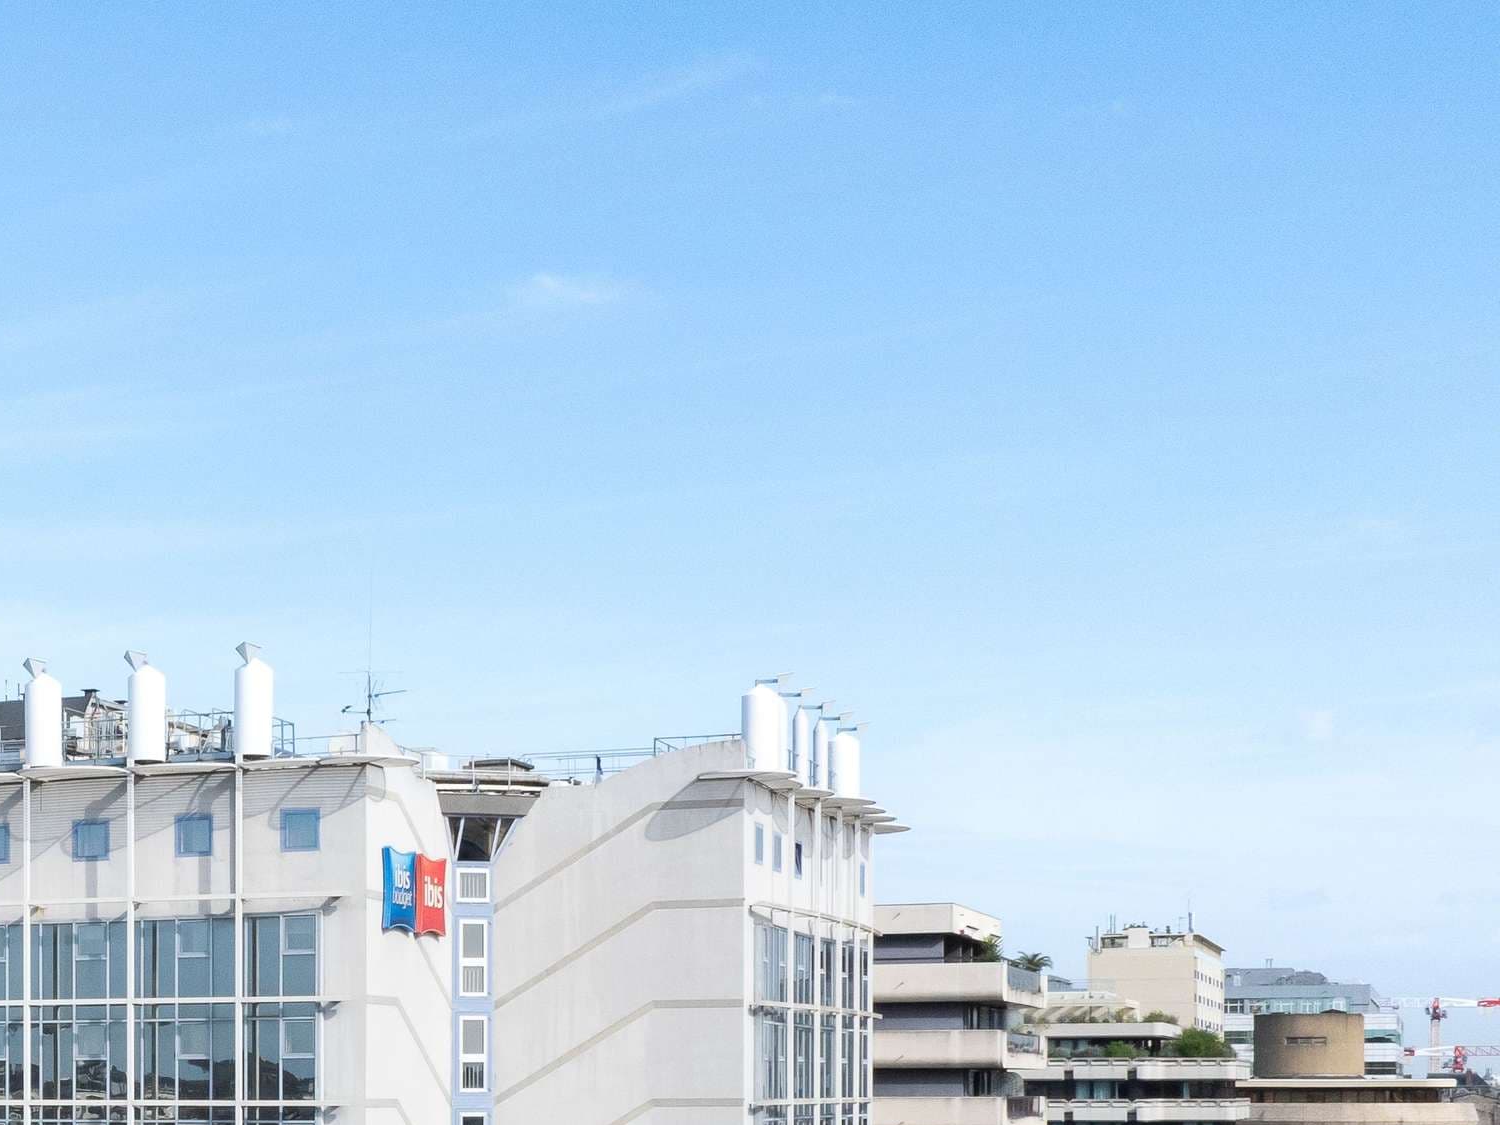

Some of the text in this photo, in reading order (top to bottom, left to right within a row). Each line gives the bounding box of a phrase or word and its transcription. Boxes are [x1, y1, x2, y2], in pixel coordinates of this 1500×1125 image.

[394, 863, 411, 888] ibis
[392, 887, 412, 909] budget
[424, 875, 443, 909] ibis
